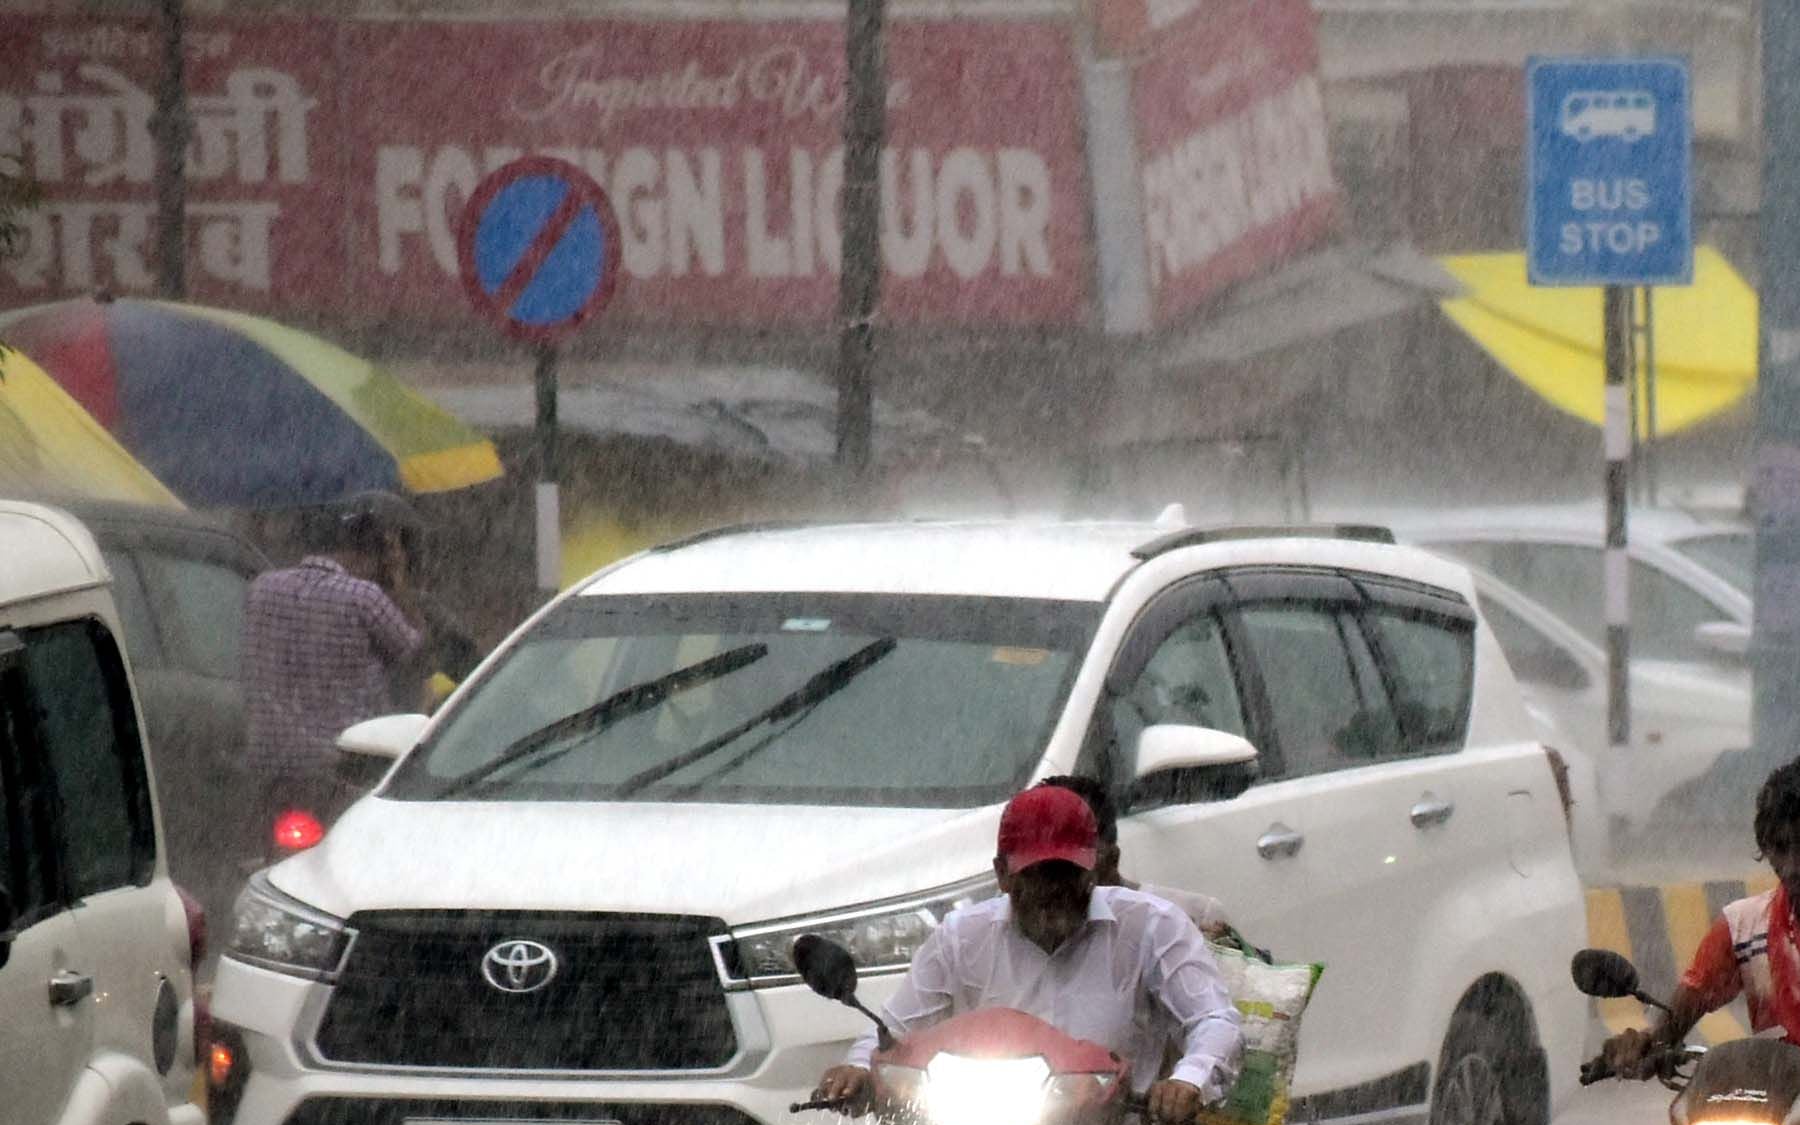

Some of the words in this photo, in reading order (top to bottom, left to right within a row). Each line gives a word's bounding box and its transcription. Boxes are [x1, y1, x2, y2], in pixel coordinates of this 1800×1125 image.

[1570, 178, 1650, 211] BUS
[376, 145, 723, 280] FOGN
[1559, 222, 1661, 255] STOP
